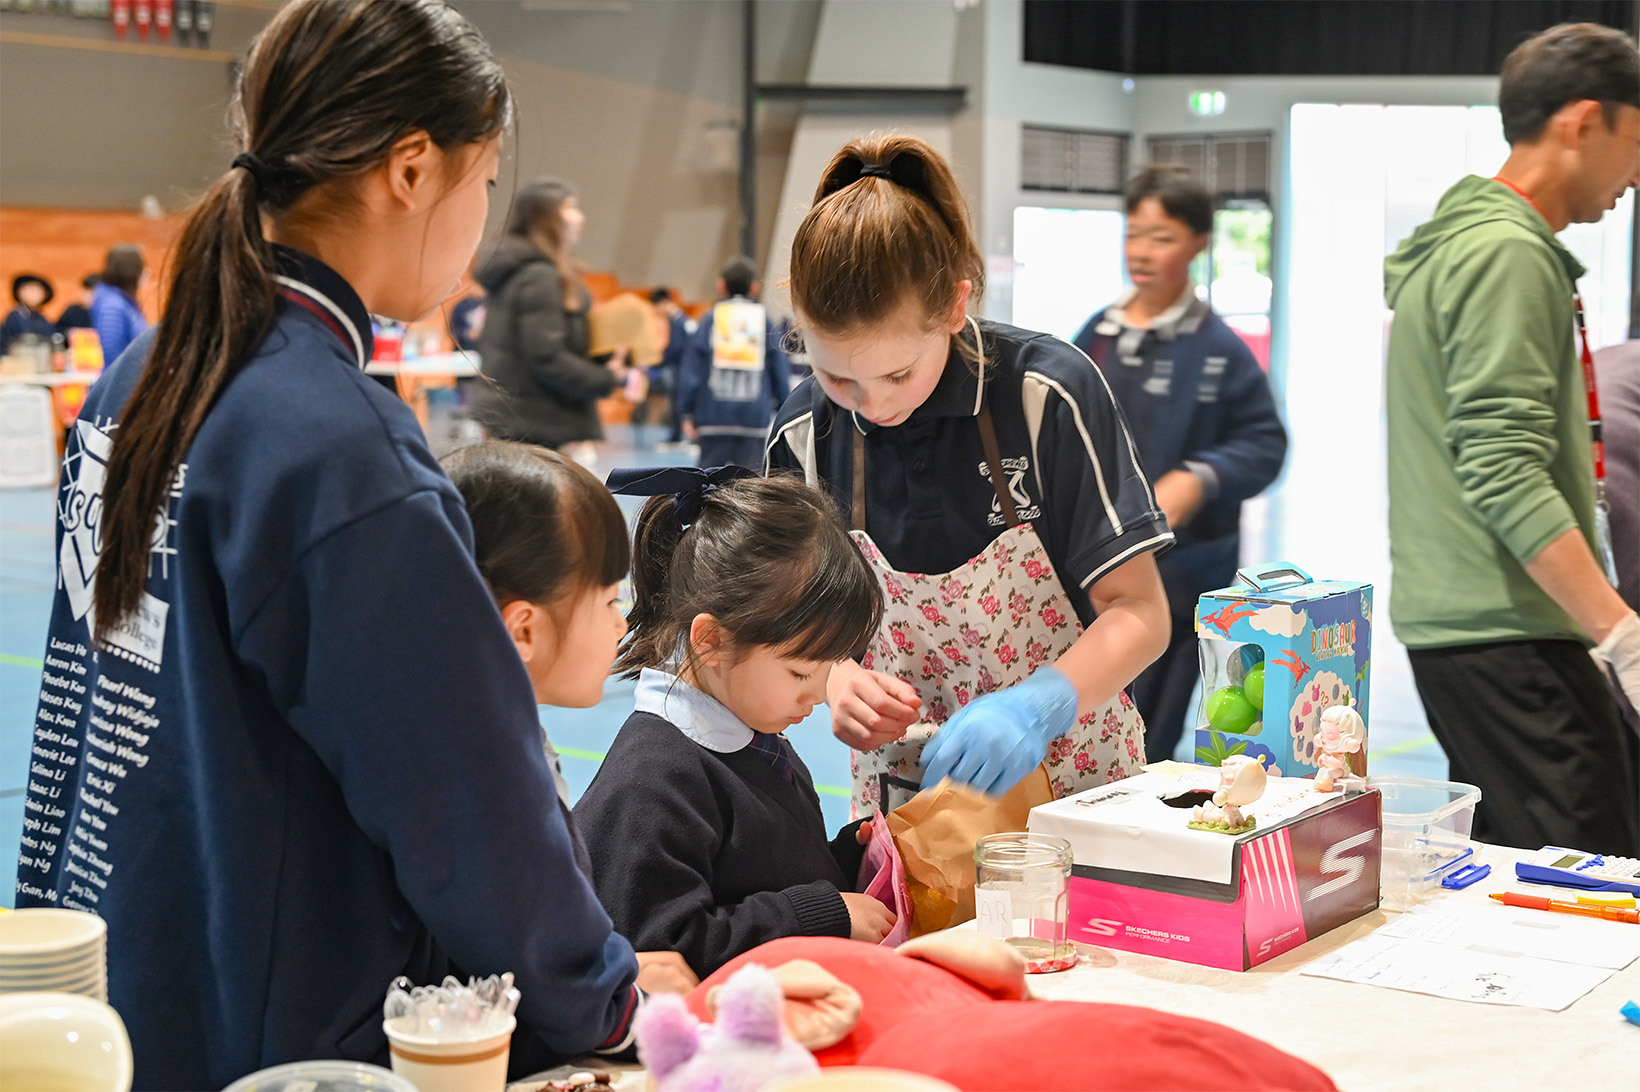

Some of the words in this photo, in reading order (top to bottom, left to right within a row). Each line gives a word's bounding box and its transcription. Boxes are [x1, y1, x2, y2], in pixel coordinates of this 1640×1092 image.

[1311, 620, 1357, 654] DINOSAUR
[39, 840, 57, 856] Ng
[34, 857, 51, 873] Ng
[1125, 925, 1170, 939] SKECHERS
[1170, 933, 1191, 943] KIDS
[1125, 932, 1171, 944] PERFORMANCE
